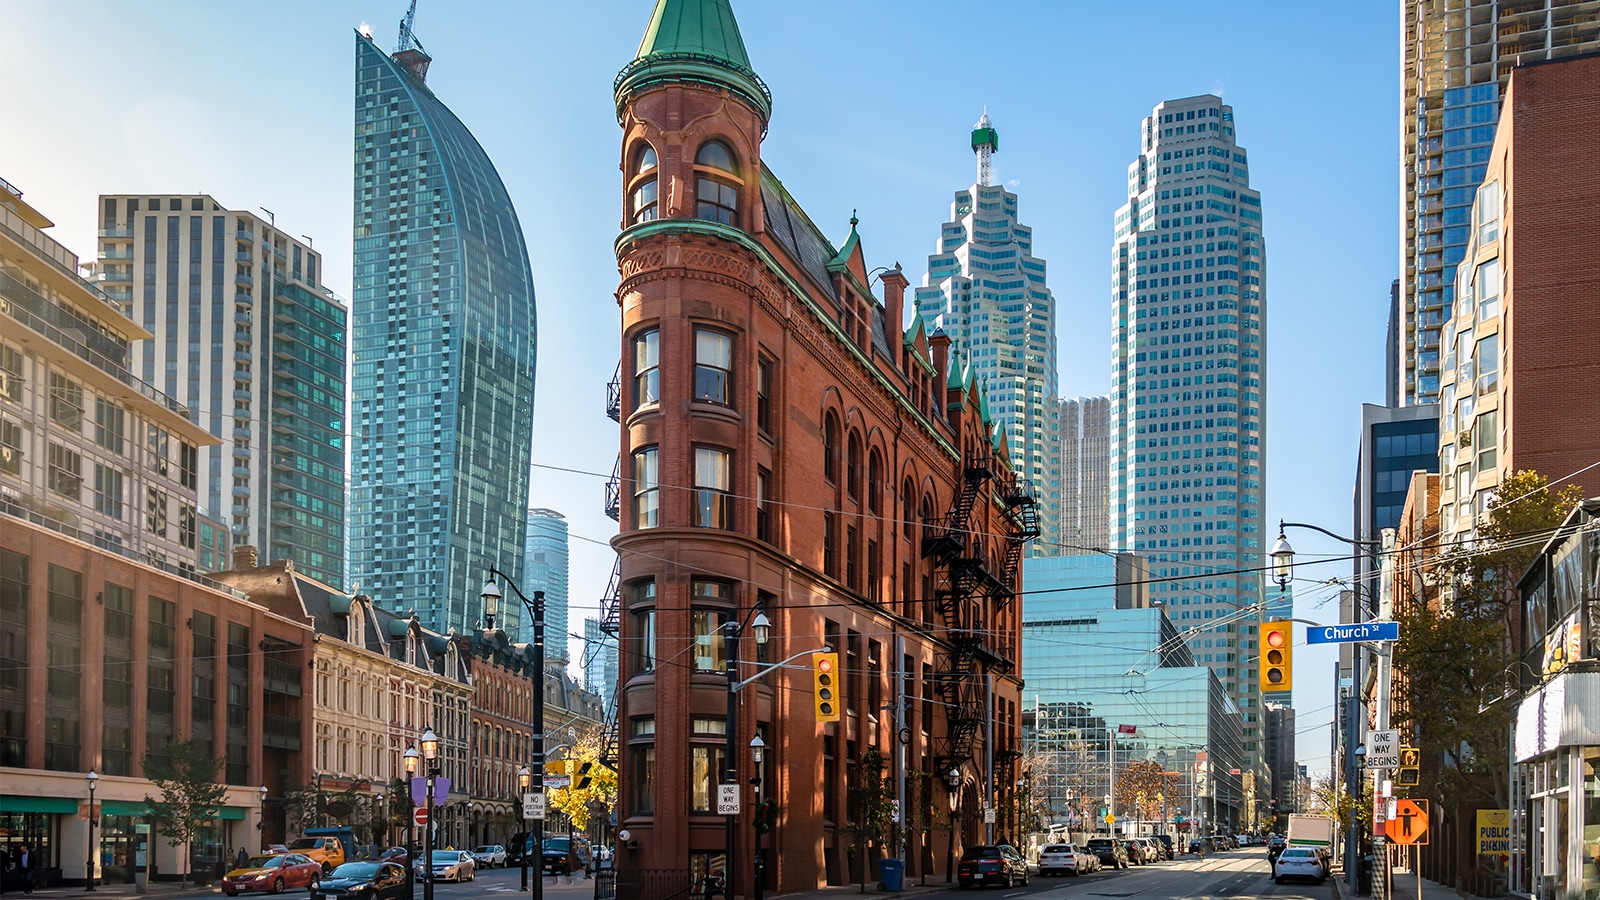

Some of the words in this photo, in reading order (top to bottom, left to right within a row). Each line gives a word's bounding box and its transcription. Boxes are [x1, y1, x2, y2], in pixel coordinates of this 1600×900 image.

[1324, 626, 1369, 639] Church
[1374, 733, 1390, 742] ONE
[1374, 745, 1390, 754] WAY
[1368, 756, 1397, 766] BEGINS
[1480, 827, 1510, 838] PUBLIC
